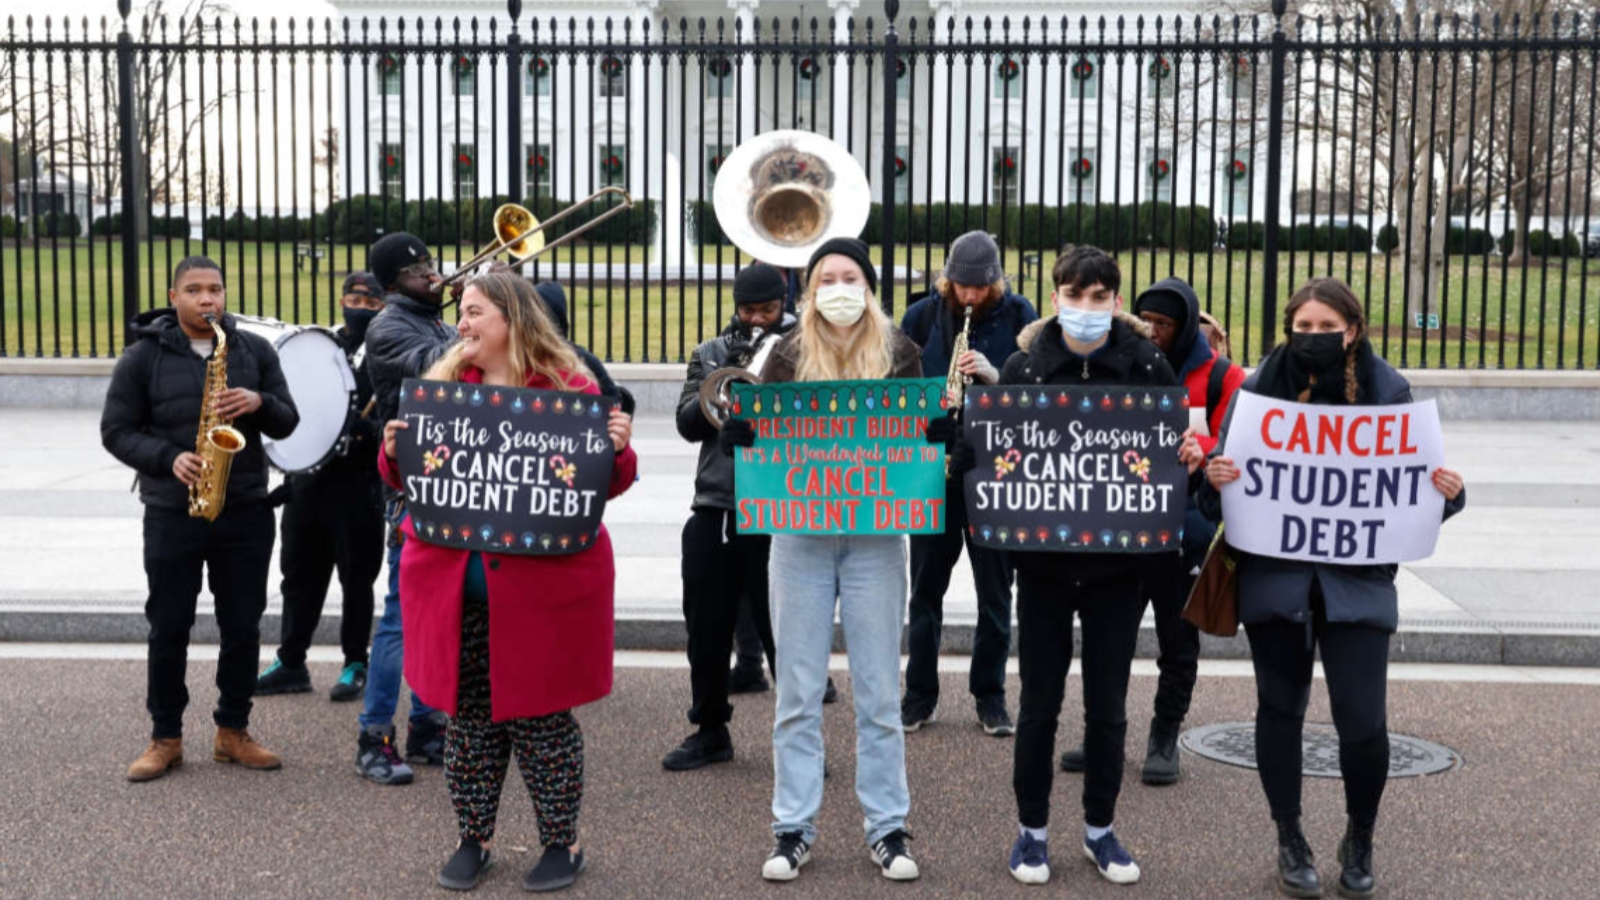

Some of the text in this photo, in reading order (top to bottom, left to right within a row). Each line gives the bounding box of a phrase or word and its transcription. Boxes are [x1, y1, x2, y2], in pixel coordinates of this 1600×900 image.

[449, 417, 491, 447] the
[498, 420, 579, 454] Season
[580, 428, 607, 454] to
[971, 420, 1183, 453] 'Tis the Season to
[1260, 408, 1418, 457] CANCEL
[451, 450, 550, 486] CANCEL
[742, 441, 938, 468] IT'S A Wonderful DAY TO
[1023, 452, 1125, 482] CANCEL
[406, 475, 597, 517] STUDENT DEBT
[785, 466, 894, 497] CANCEL
[976, 482, 1173, 513] STUDENT DEBT
[1244, 457, 1428, 508] STUDENT
[738, 498, 944, 530] STUDENT DEBT
[1280, 514, 1385, 559] DEBT
